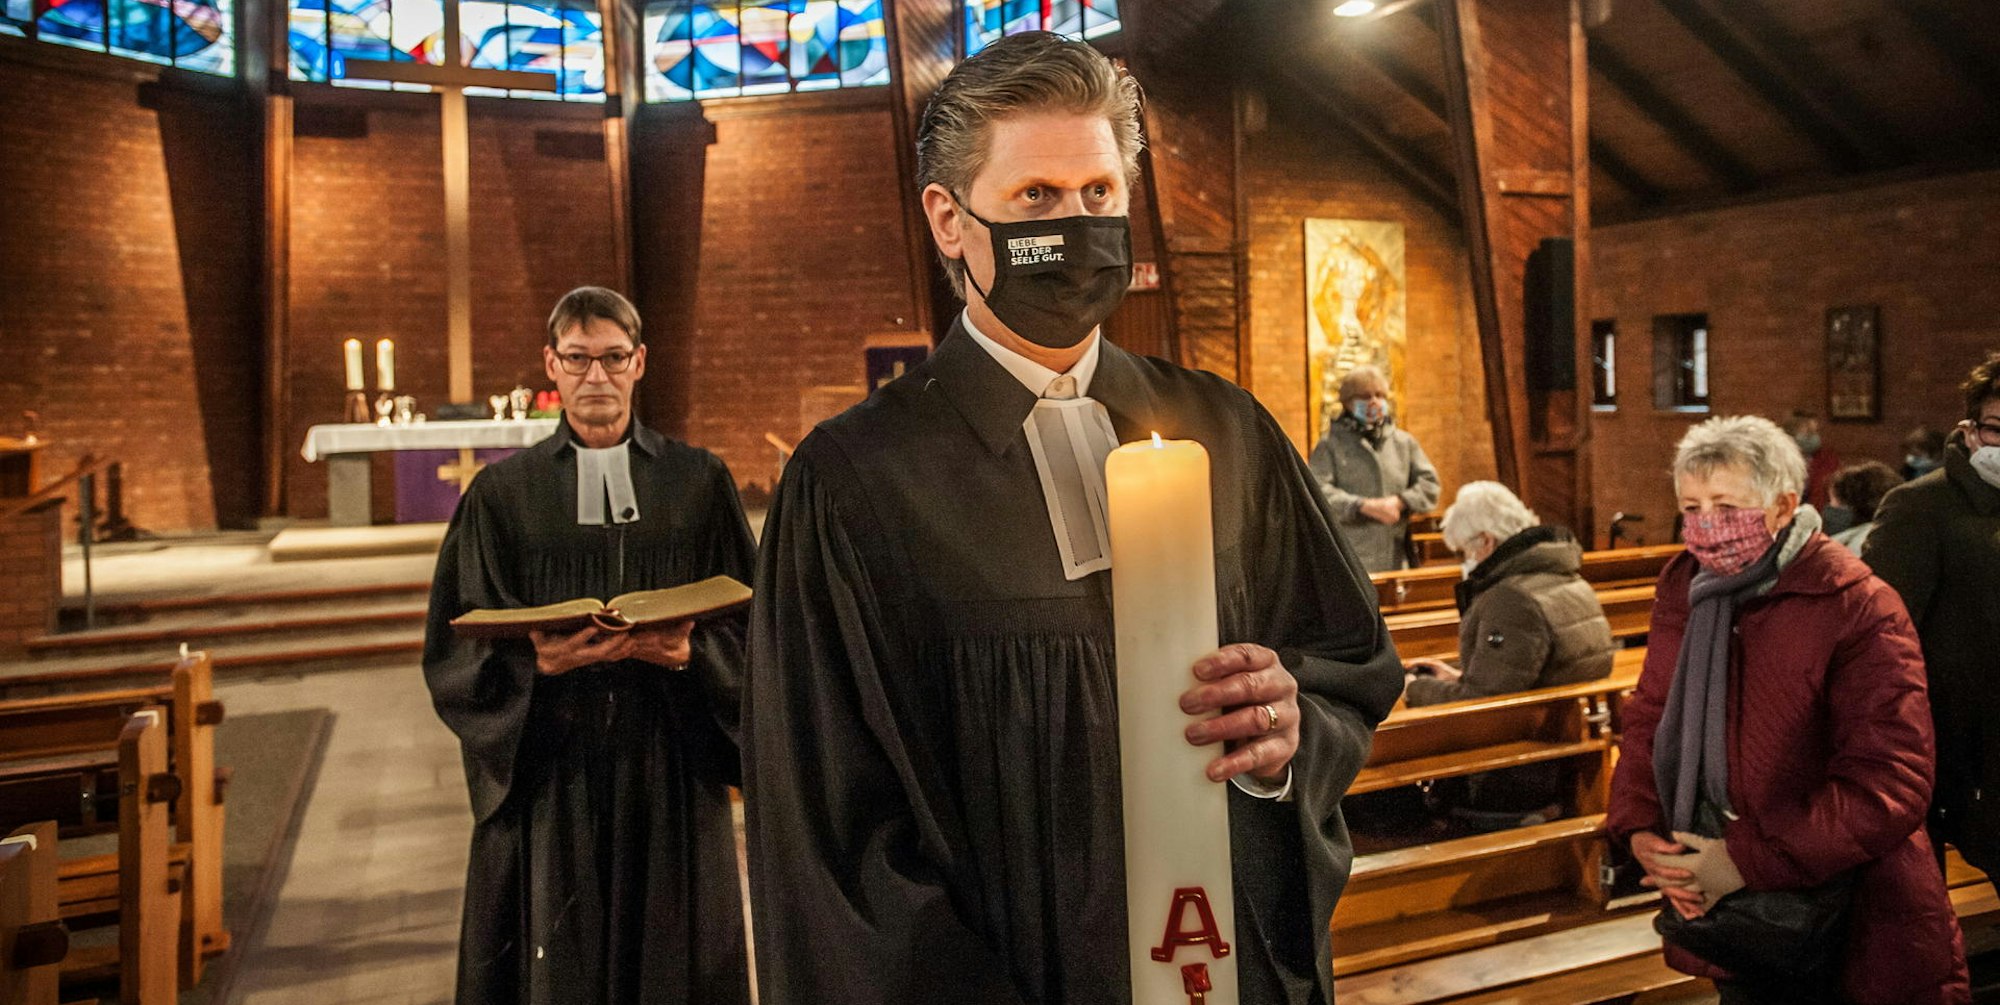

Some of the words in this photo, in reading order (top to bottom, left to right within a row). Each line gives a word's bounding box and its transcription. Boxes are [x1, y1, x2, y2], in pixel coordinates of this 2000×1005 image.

[1010, 238, 1037, 248] LIEBE
[1010, 248, 1030, 257] TUT
[1031, 247, 1052, 256] DER
[1011, 255, 1040, 266] SEELE
[1041, 253, 1065, 262] GUT.
[1151, 887, 1230, 962] A
